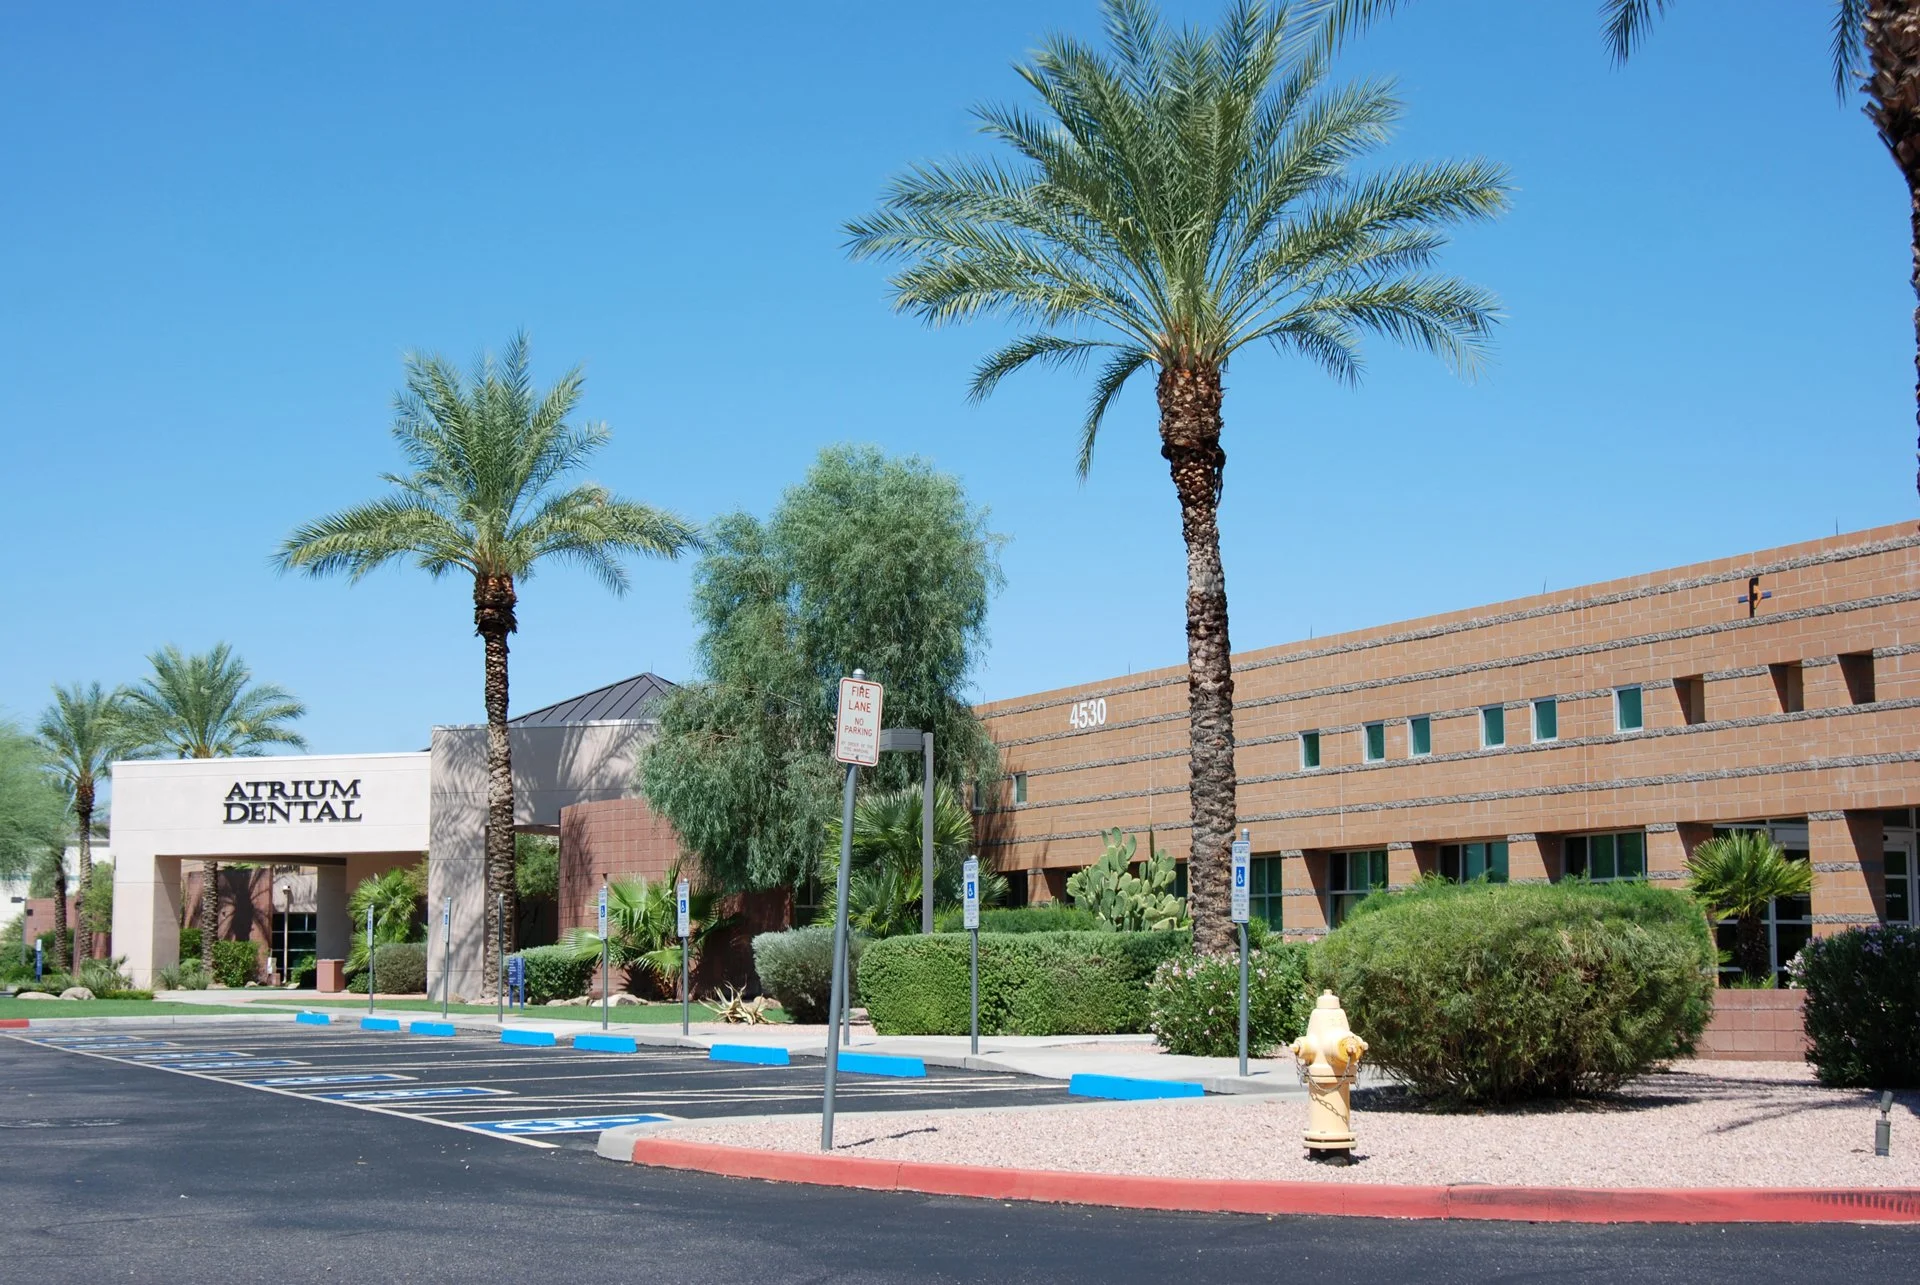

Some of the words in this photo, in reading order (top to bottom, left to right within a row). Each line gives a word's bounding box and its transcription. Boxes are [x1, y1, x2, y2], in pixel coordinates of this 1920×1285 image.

[851, 686, 870, 699] FIRE
[848, 700, 871, 713] LANE
[1070, 698, 1106, 729] 4530
[854, 717, 864, 726] NO
[844, 725, 873, 737] PARKING
[225, 779, 362, 801] ATRIUM
[223, 800, 362, 824] DENTAL
